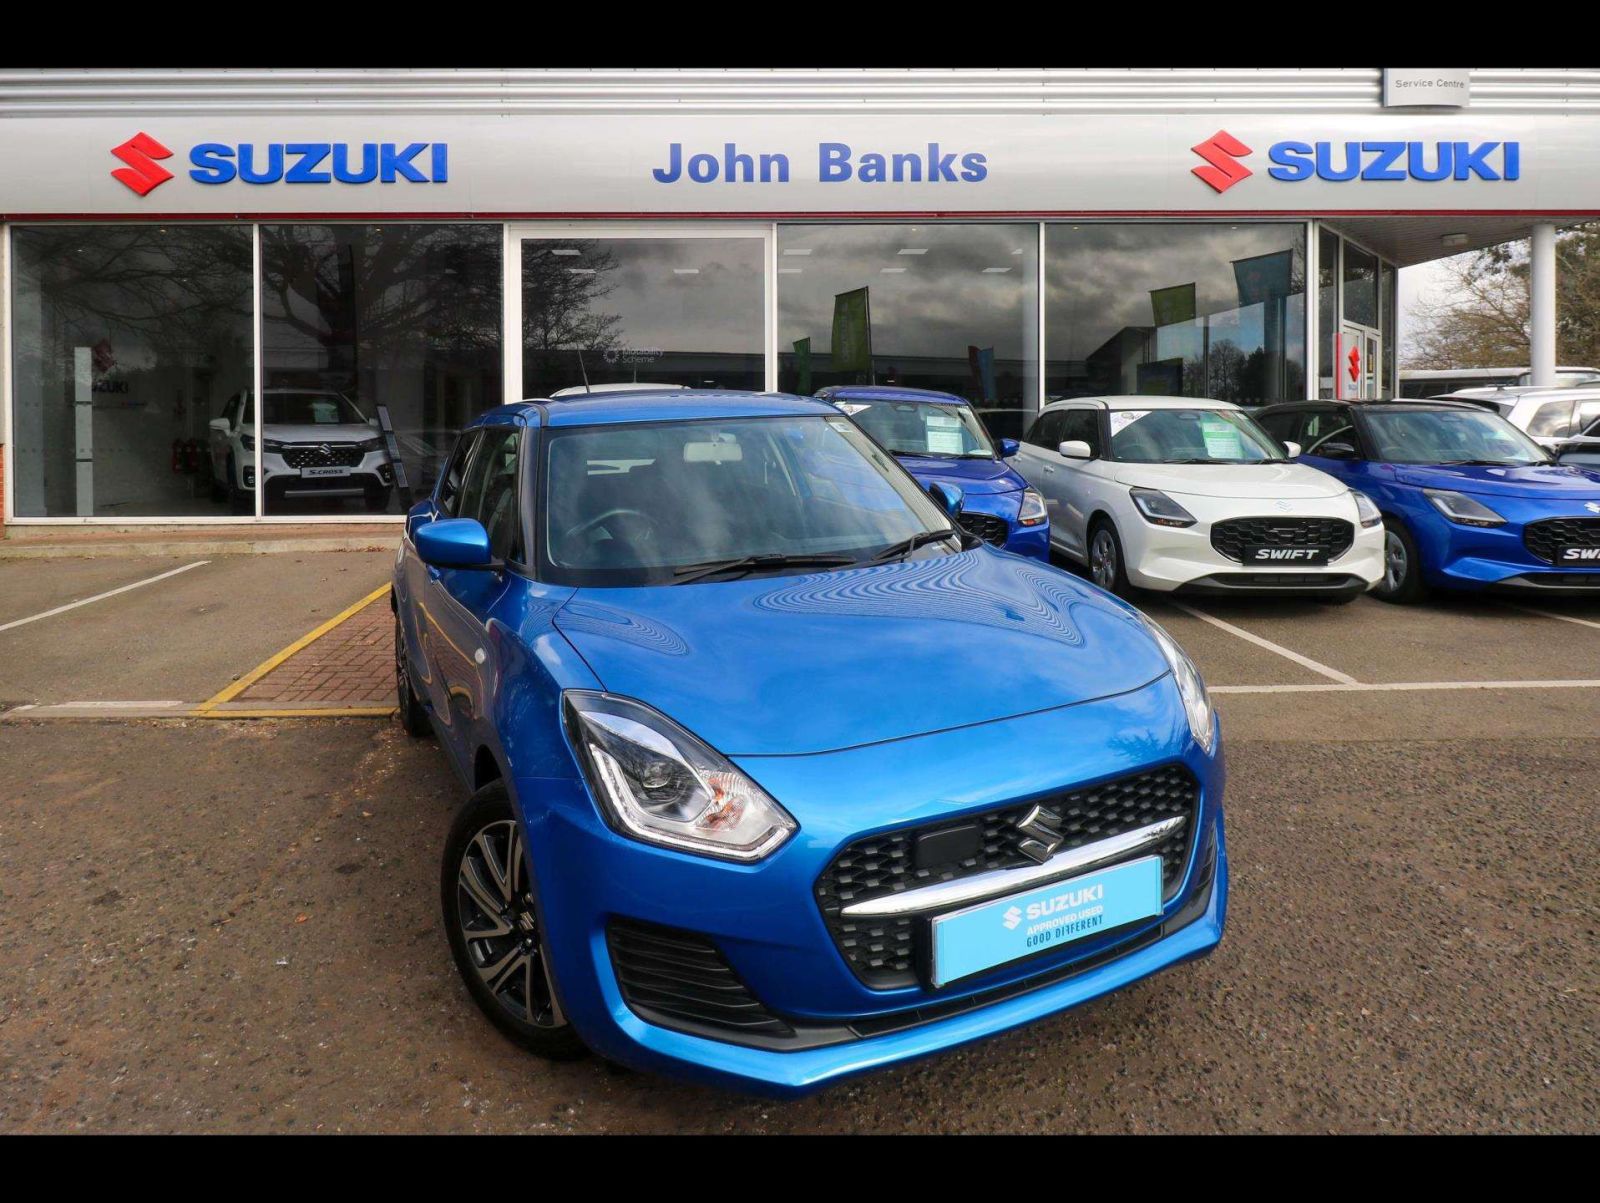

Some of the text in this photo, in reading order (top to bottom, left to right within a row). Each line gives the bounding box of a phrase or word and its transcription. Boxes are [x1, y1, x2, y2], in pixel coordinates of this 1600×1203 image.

[1395, 79, 1465, 88] Service Centre
[189, 143, 448, 184] SUZUKI
[652, 142, 988, 183] John Banks
[1268, 141, 1519, 181] SUZUKI
[622, 355, 655, 363] Scheme
[1255, 548, 1320, 560] SWIFT
[1563, 548, 1600, 560] SW
[1026, 883, 1104, 920] SUZUKI
[1027, 905, 1104, 935] APPROVED USED
[1026, 931, 1052, 948] GOOD
